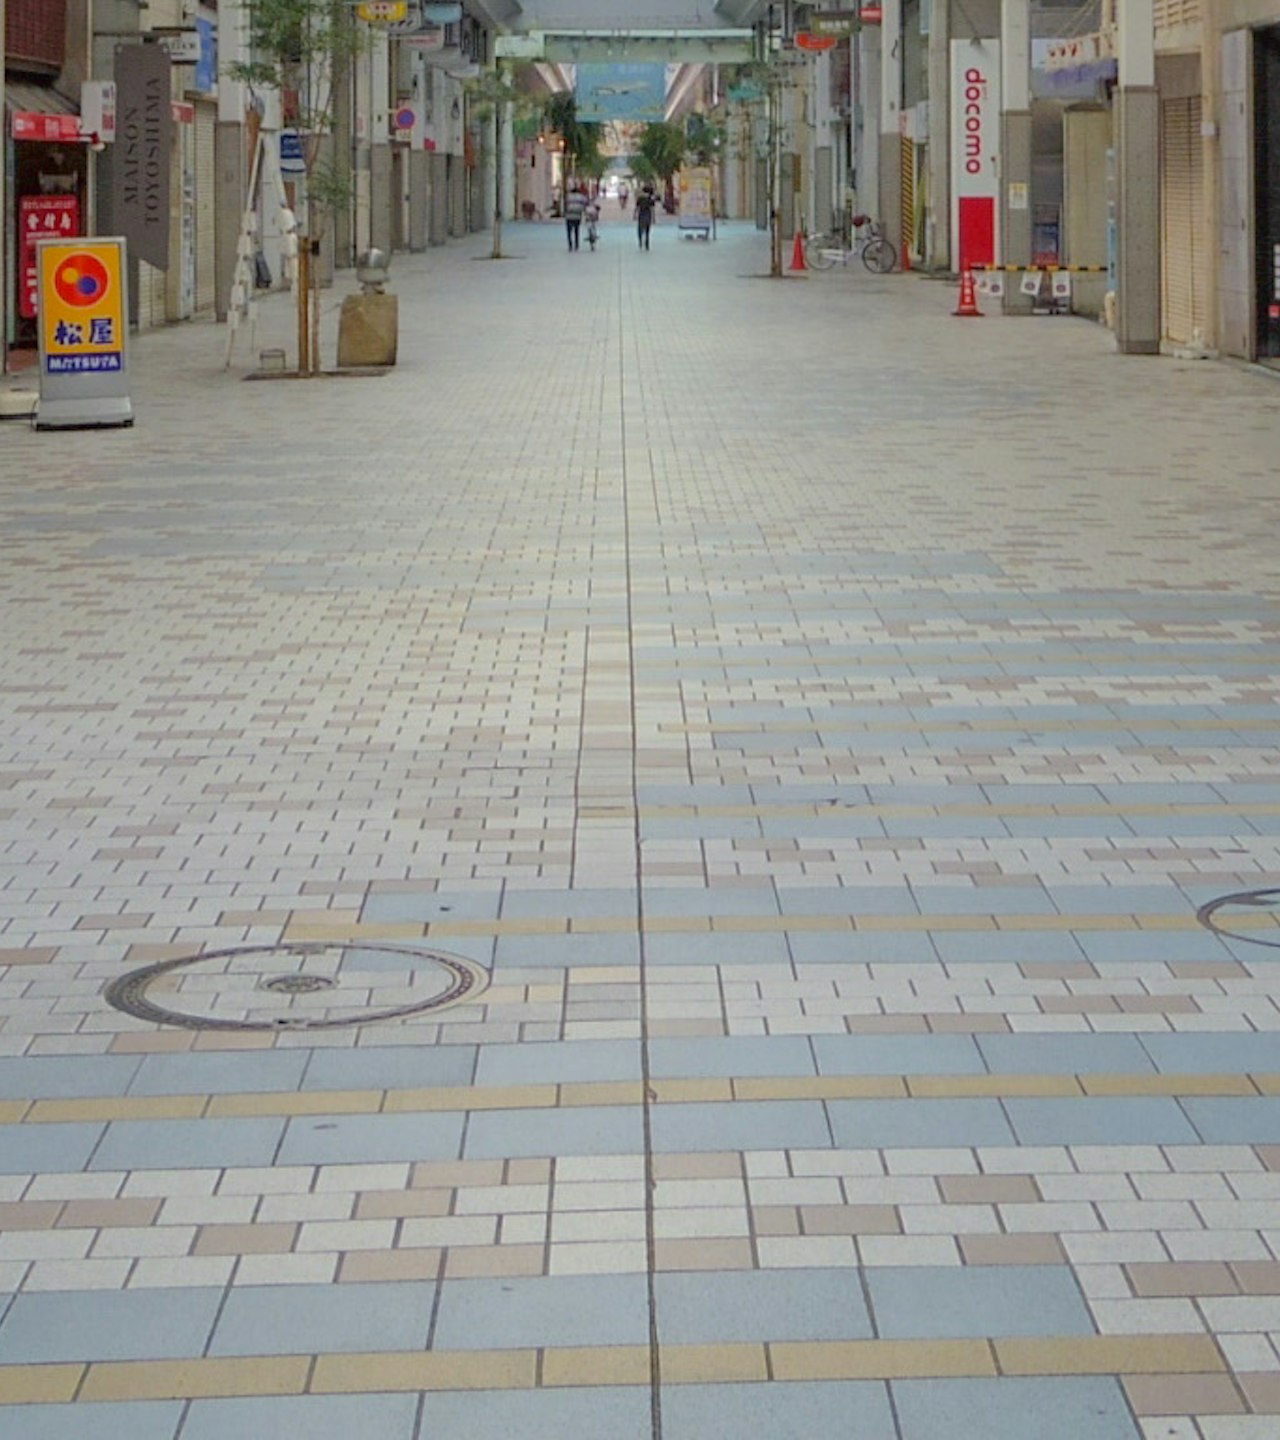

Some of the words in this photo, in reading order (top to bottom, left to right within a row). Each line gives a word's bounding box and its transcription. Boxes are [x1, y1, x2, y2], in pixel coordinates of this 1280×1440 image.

[124, 108, 139, 206] MAISON
[145, 77, 161, 227] TOYOSHIMA
[965, 68, 987, 174] docomo
[49, 356, 119, 369] MATSUYA
[54, 318, 114, 345] 松屋
